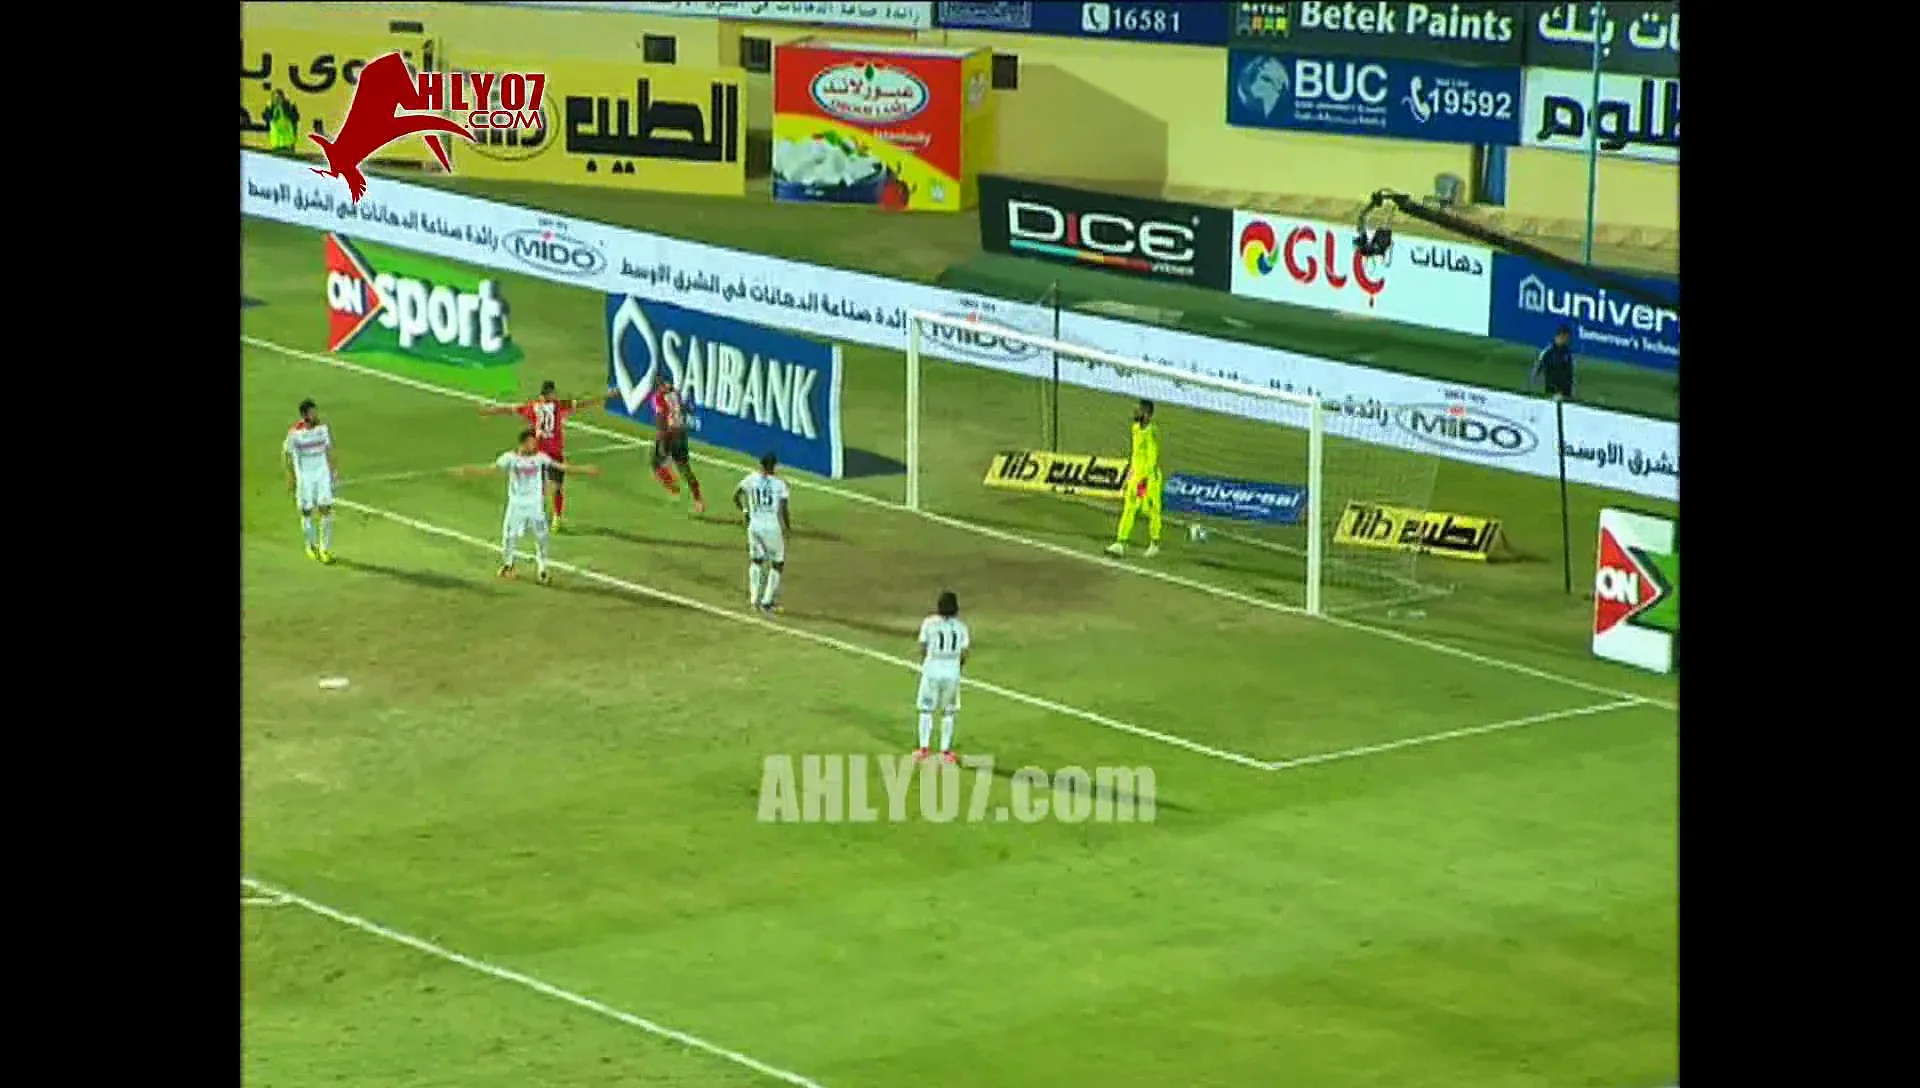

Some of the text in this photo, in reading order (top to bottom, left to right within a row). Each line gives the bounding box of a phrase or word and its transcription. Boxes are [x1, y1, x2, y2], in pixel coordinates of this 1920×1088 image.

[1112, 8, 1180, 33] 16581
[1300, 2, 1512, 41] Betek Paints
[1295, 60, 1388, 103] BUC
[1428, 87, 1512, 120] 19592
[565, 78, 737, 174] الطيب
[1008, 199, 1195, 262] DICE
[515, 236, 596, 269] MIDO
[1410, 244, 1484, 277] دهانات
[327, 272, 365, 316] ON
[673, 268, 720, 294] الشرق
[722, 276, 747, 302] في
[749, 283, 819, 314] الدهانات
[374, 273, 503, 354] sport
[1547, 287, 1680, 332] univer
[661, 329, 818, 441] SAIBANK
[1411, 410, 1522, 450] MIDO
[1181, 480, 1301, 509] universal
[1596, 566, 1639, 606] ON
[937, 630, 958, 651] 11
